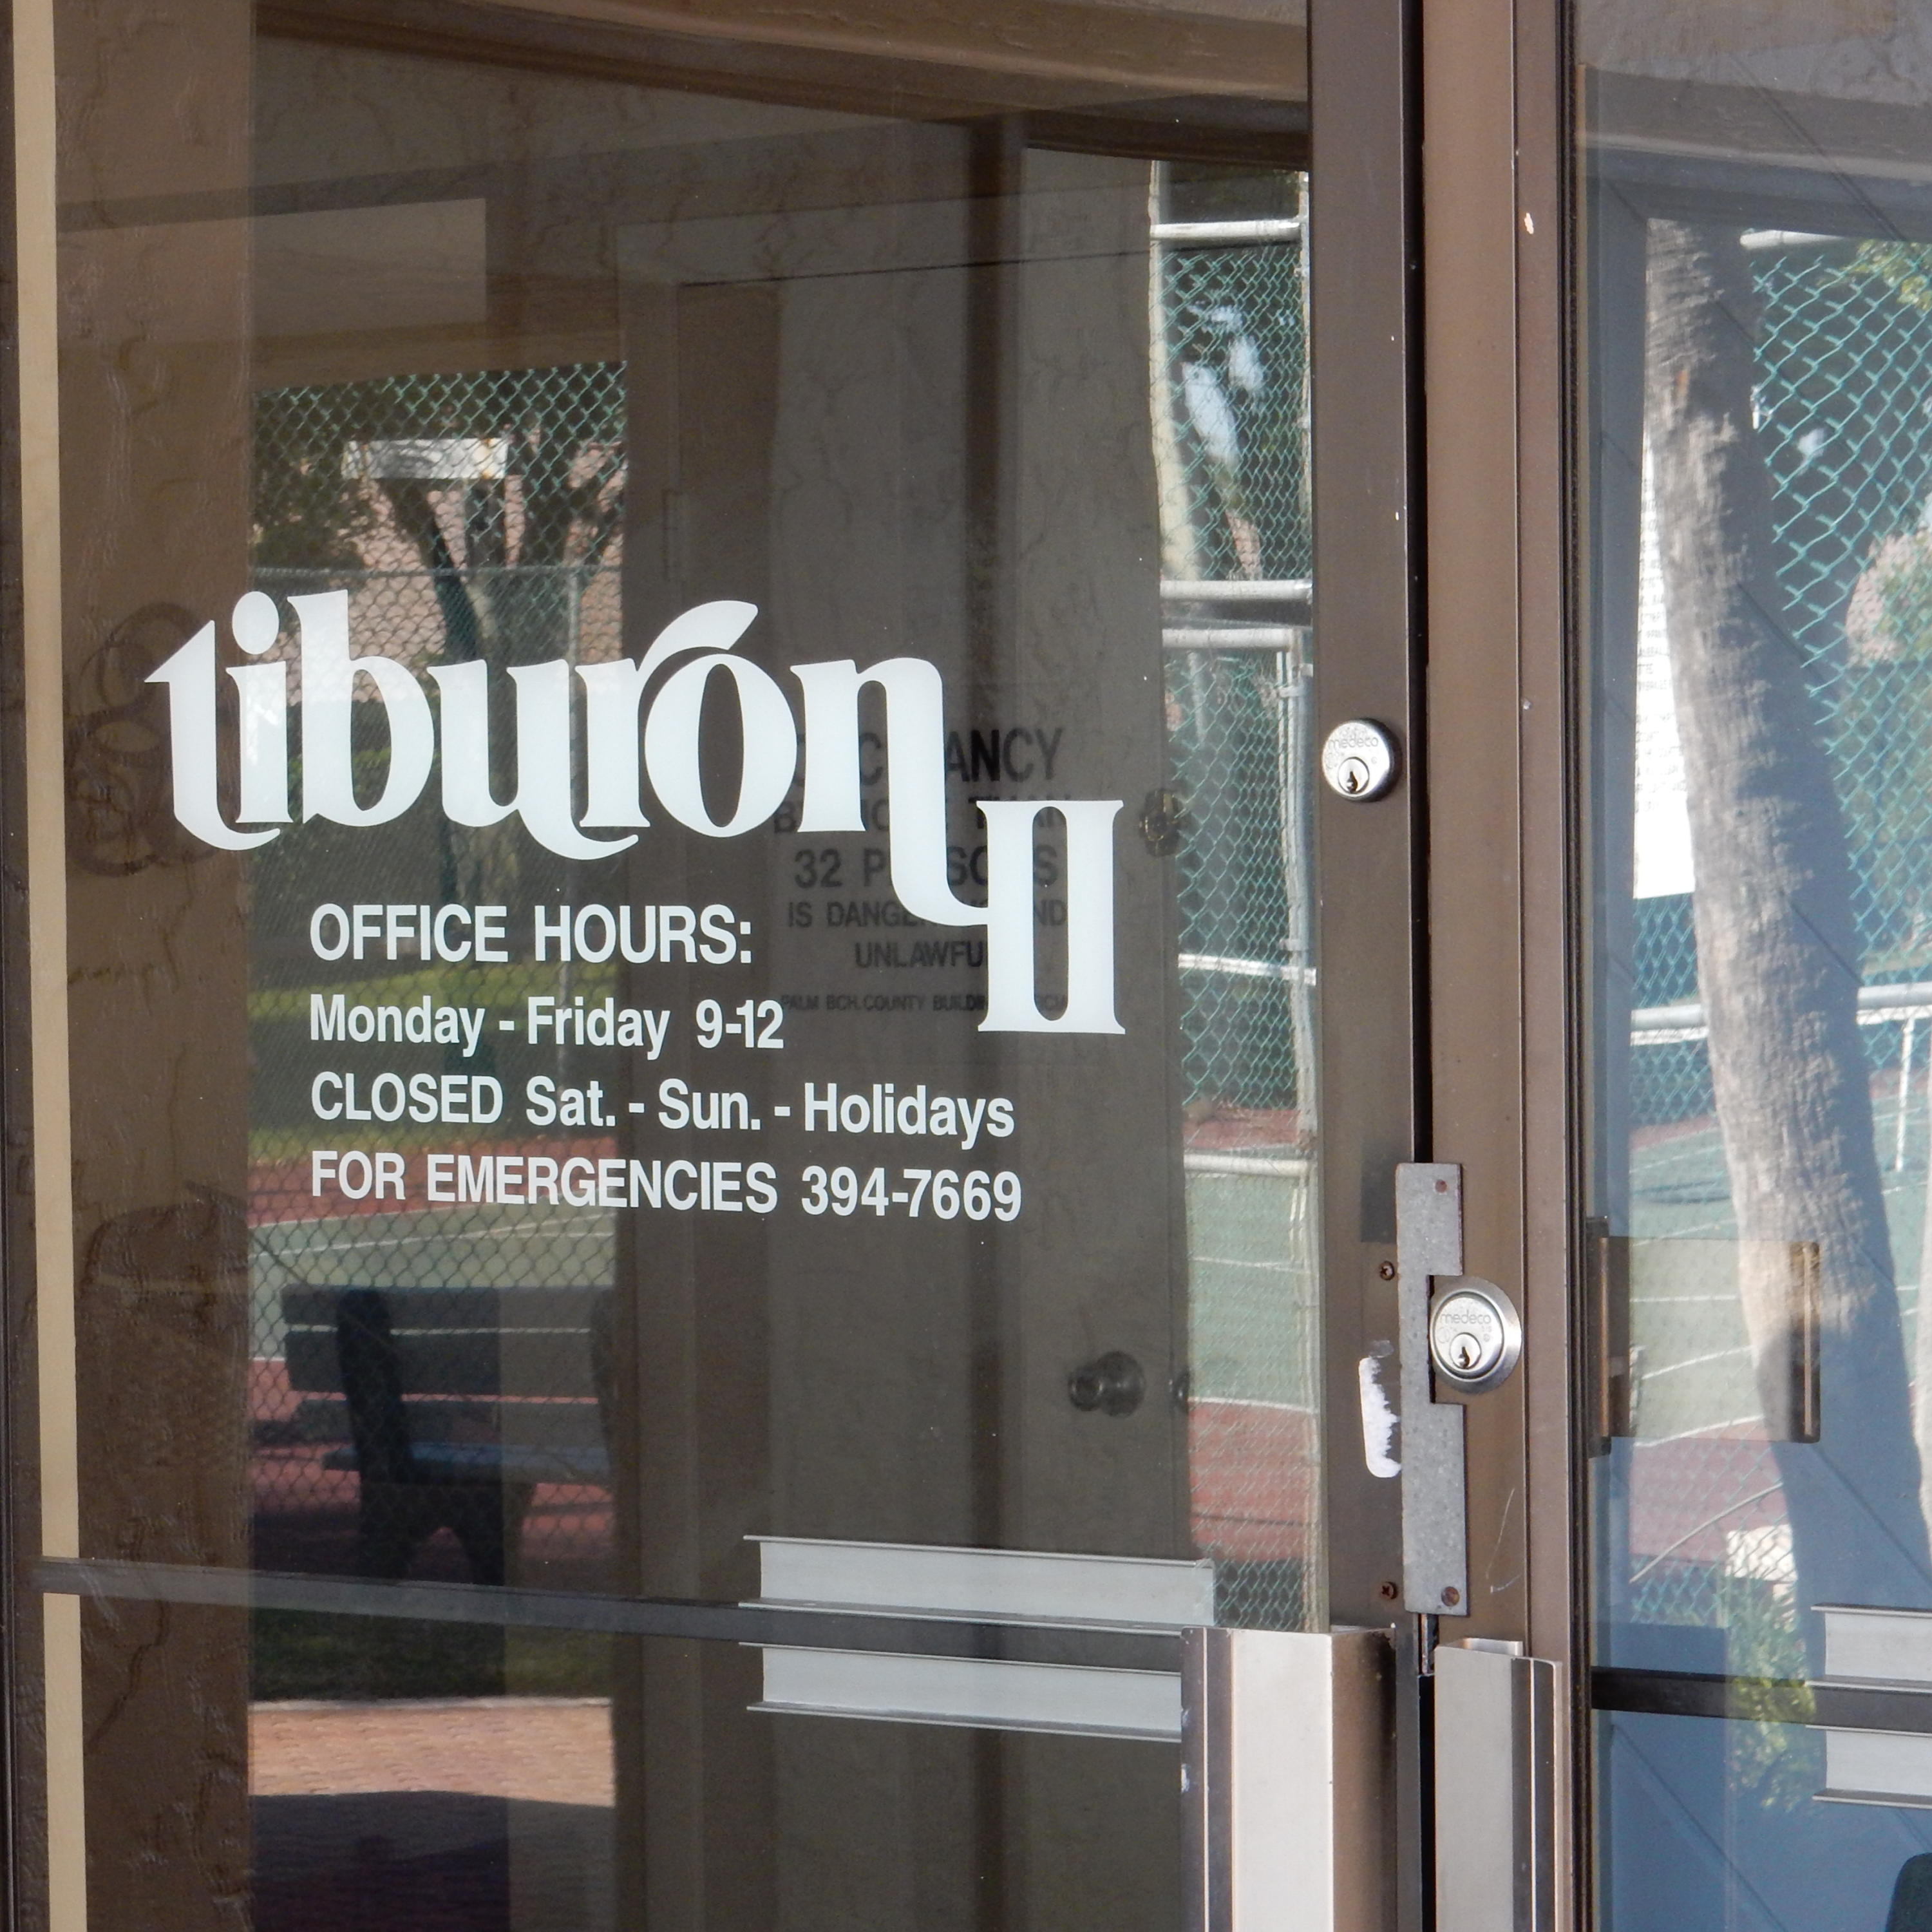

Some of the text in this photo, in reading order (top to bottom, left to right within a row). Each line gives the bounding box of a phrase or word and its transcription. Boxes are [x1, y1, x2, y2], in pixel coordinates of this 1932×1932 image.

[1329, 732, 1379, 749] medeco
[794, 844, 1058, 888] 32 PSOS
[310, 903, 752, 964] OFFICE HOURS:
[788, 901, 813, 928] IS
[855, 940, 986, 968] UNLAWFU
[310, 994, 486, 1058] Monday
[528, 996, 670, 1061] Friday
[696, 999, 784, 1049] 9-12
[312, 1071, 503, 1124] CLOSED
[526, 1075, 616, 1127] Sat.
[658, 1078, 761, 1130] Sun.
[804, 1082, 1015, 1151] Holidays
[312, 1150, 1022, 1222] FOR EMERGENCIES 394-7669
[1441, 1309, 1492, 1325] medeco
